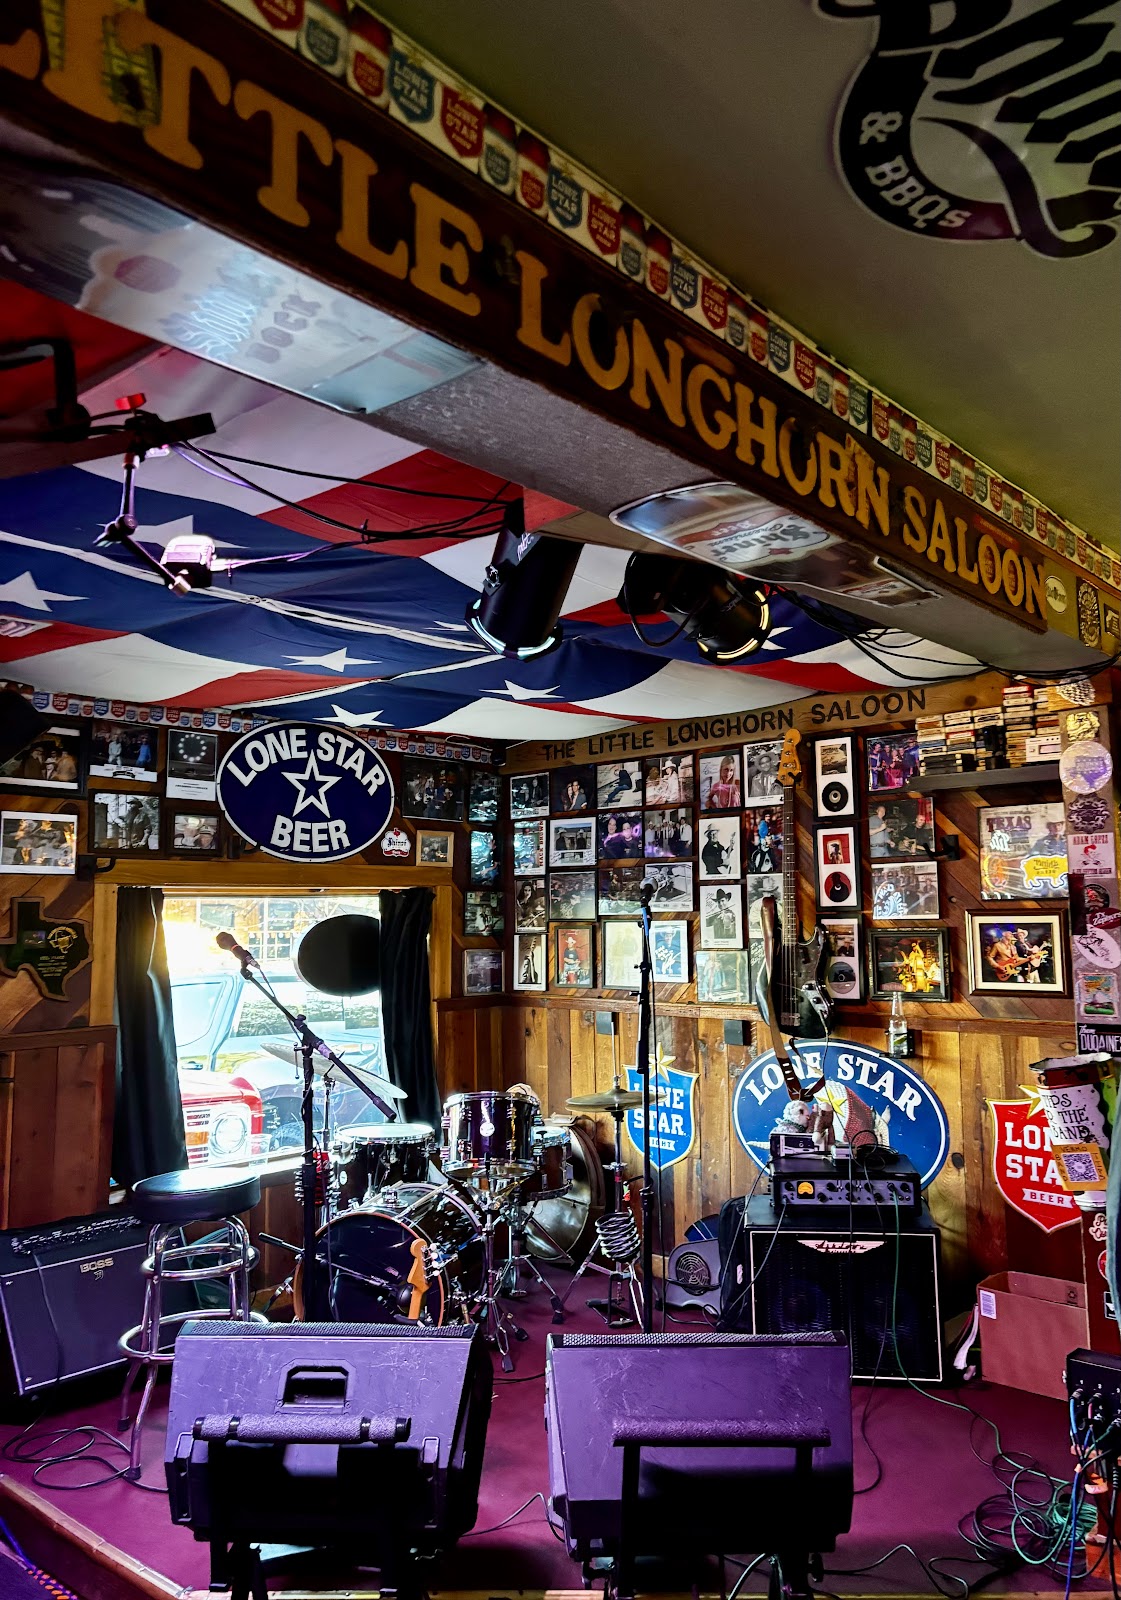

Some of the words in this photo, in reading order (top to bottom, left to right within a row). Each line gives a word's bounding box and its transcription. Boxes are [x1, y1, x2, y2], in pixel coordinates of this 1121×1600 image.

[858, 111, 903, 146] &
[864, 155, 972, 230] BBQs
[0, 0, 484, 316] ITTLE
[514, 250, 890, 537] LONGHORN
[902, 485, 1048, 620] SALOON
[711, 524, 811, 557] Shiner
[542, 739, 576, 762] THE
[587, 729, 655, 757] LITTLE
[666, 707, 794, 744] LONGHORN
[810, 688, 927, 725] SALOON
[226, 728, 308, 787] LONE
[316, 731, 386, 797] STAR
[270, 815, 351, 853] BEER
[986, 815, 1032, 833] TEXAS
[745, 1052, 823, 1106] LONE
[837, 1053, 922, 1121] STAR
[1058, 1107, 1089, 1124] THE
[1005, 1153, 1062, 1187] STA
[1030, 1192, 1064, 1205] BEER
[80, 1258, 114, 1273] BOSS
